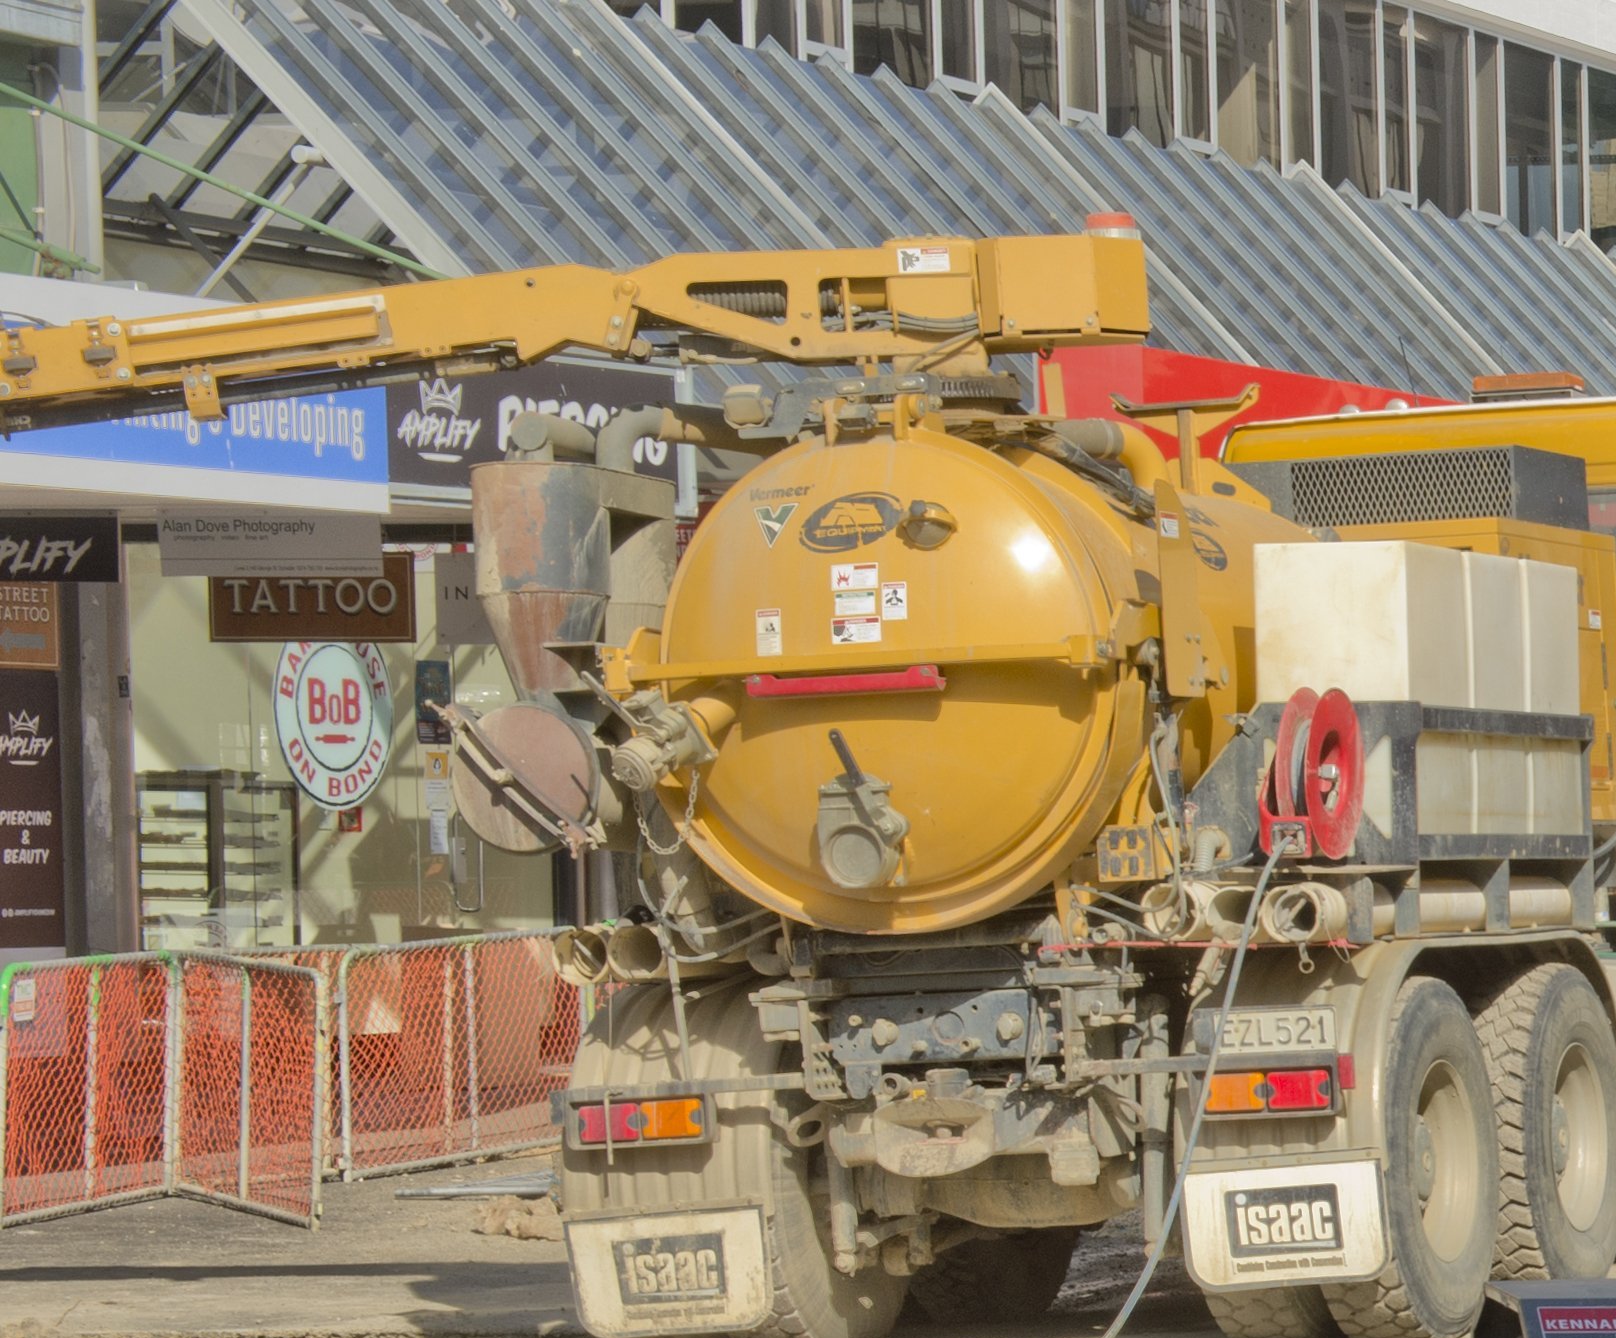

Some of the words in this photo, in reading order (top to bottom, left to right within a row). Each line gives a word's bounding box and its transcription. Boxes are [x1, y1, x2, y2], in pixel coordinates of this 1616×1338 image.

[397, 409, 481, 450] AMPLIFY
[750, 485, 810, 501] Vermeer
[162, 519, 191, 532] Alan
[196, 519, 229, 532] Dove
[233, 519, 315, 535] Photography
[223, 578, 398, 615] TATTOO
[328, 739, 382, 797] BOND
[21, 830, 31, 845] &
[3, 848, 50, 866] BEAUTY
[1220, 1015, 1329, 1049] EZL521
[1235, 1193, 1334, 1246] isaac
[622, 1242, 719, 1295] isaac
